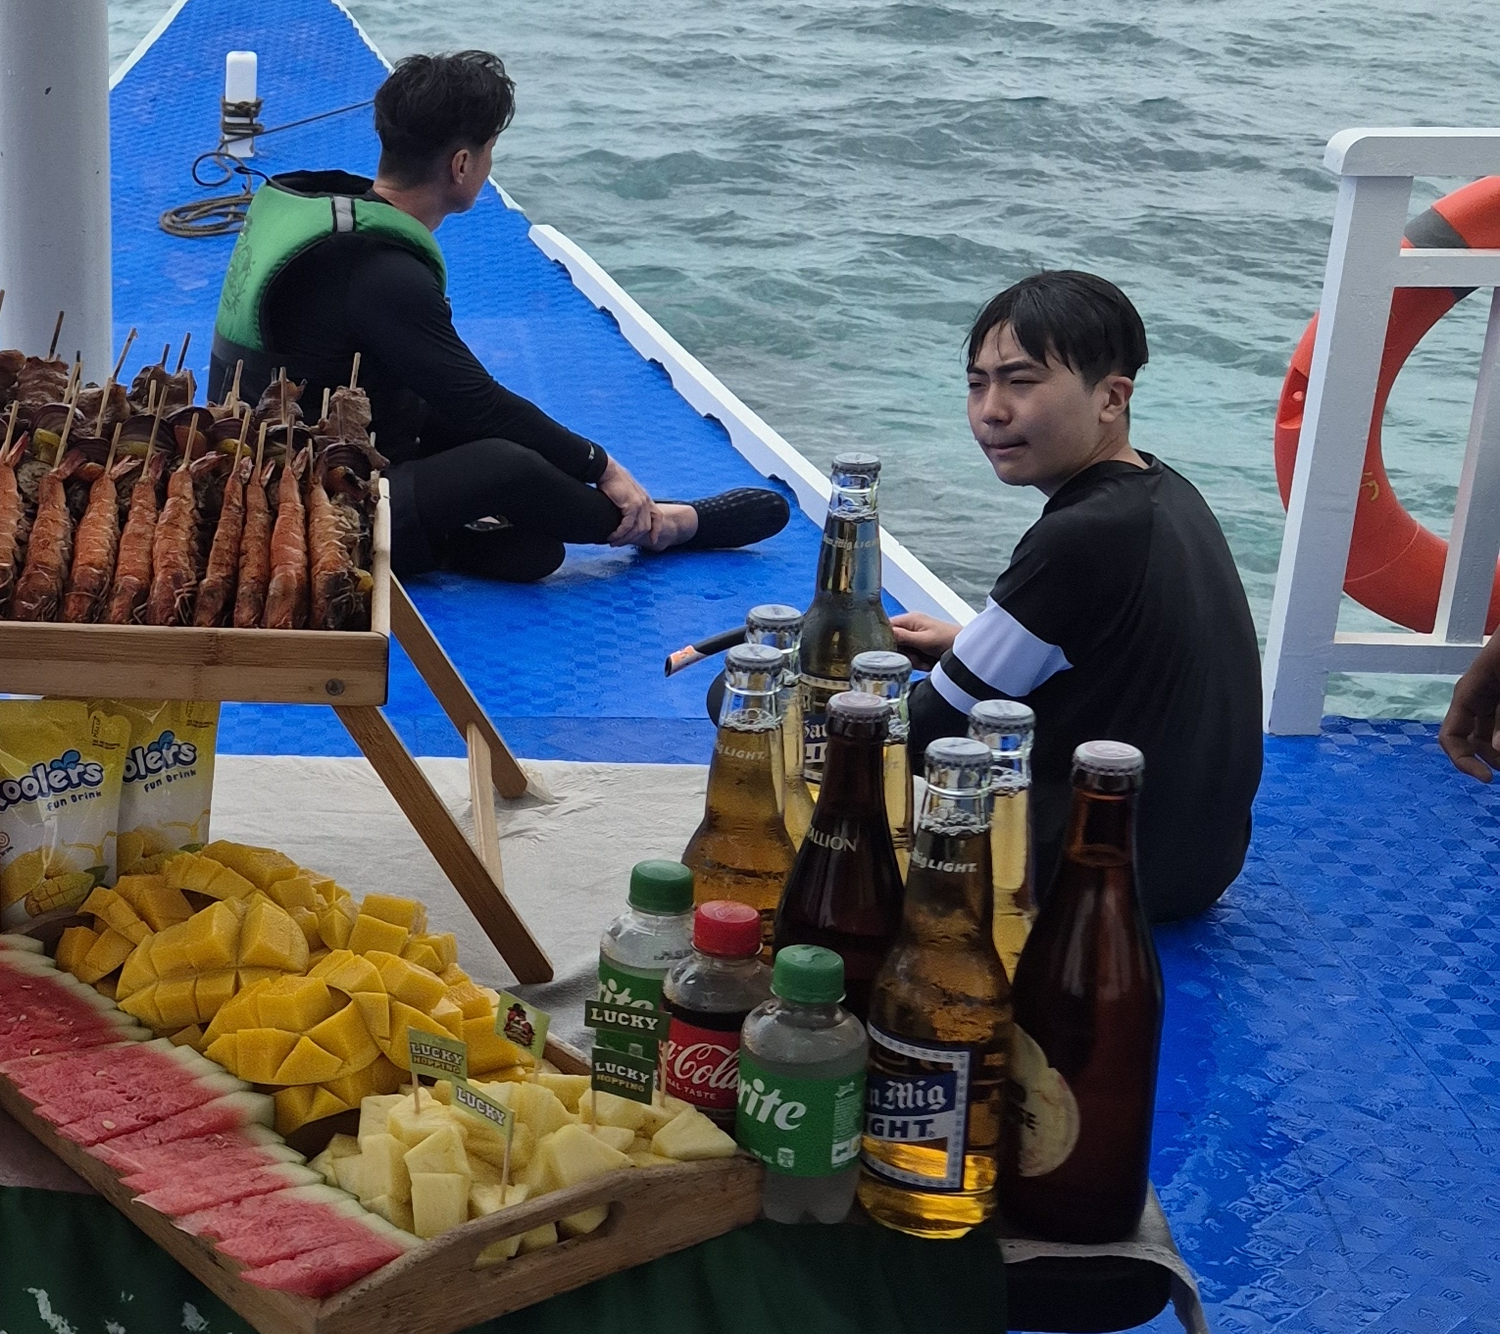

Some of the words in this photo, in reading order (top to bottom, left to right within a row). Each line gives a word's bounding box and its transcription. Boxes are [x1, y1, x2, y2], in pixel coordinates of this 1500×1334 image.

[0, 762, 105, 811] oolers
[928, 859, 978, 873] LIGHT
[590, 1007, 659, 1031] LUCKY
[410, 1041, 463, 1066] LUCKY
[412, 1056, 461, 1075] HOPPING
[594, 1061, 650, 1084] LUCKY
[596, 1073, 645, 1093] HOPPING
[684, 1086, 717, 1100] TASTE
[456, 1085, 506, 1127] LUCKY
[737, 1078, 807, 1131] rite
[882, 1080, 948, 1110] Mig
[870, 1118, 935, 1139] GHT
